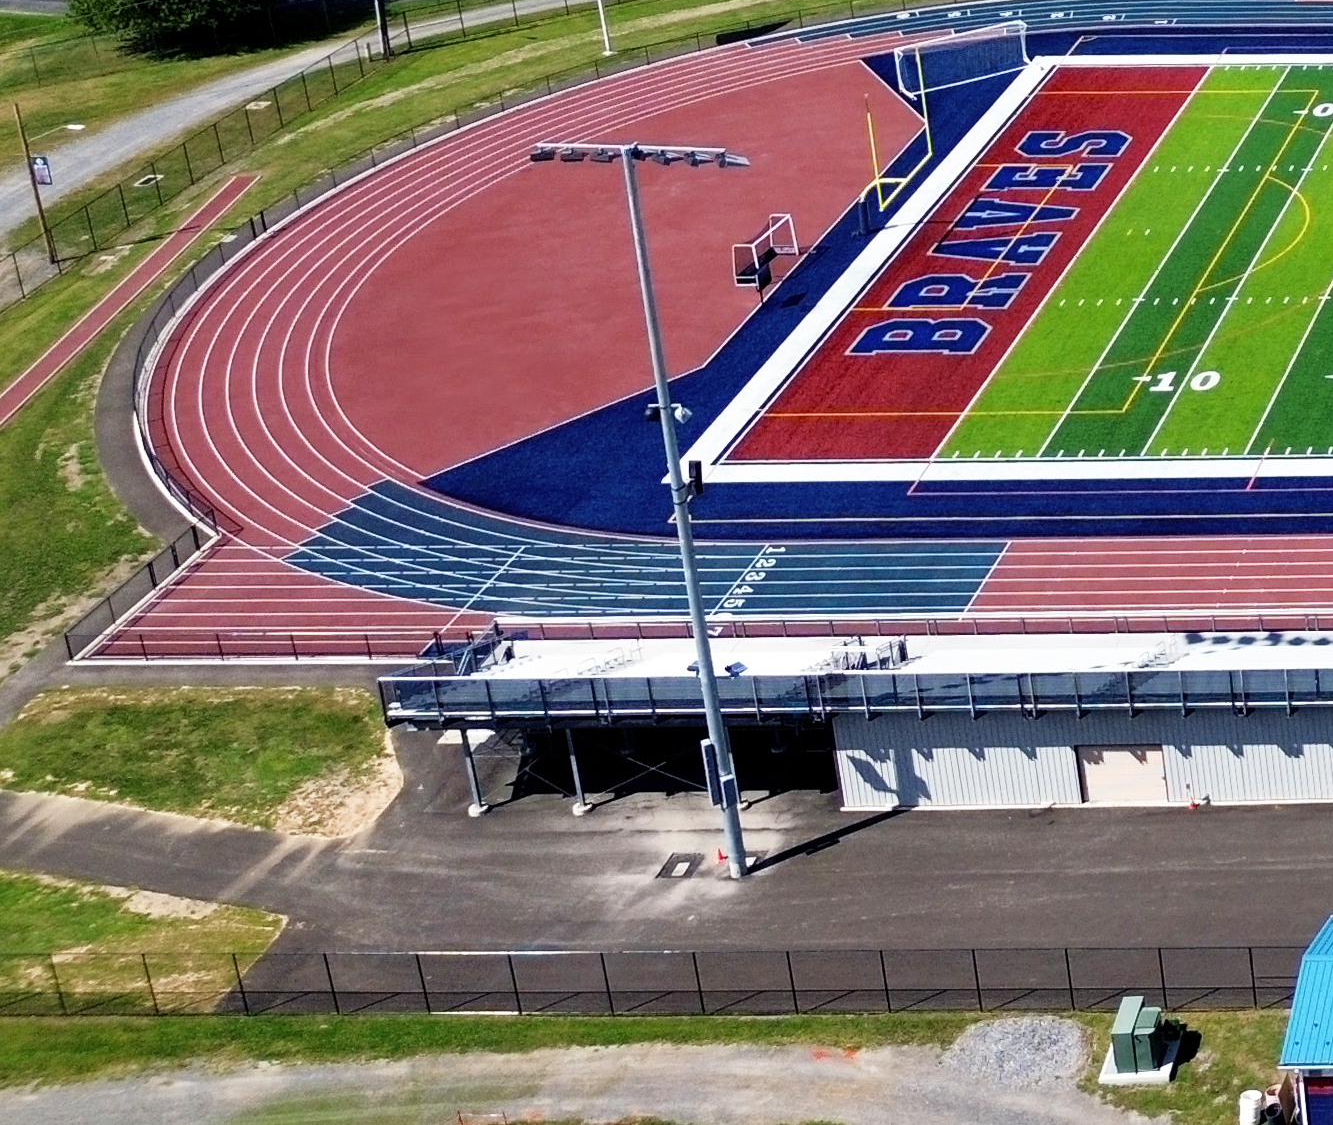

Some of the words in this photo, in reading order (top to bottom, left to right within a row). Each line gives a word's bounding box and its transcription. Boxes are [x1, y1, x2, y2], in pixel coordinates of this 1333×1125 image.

[844, 130, 1133, 355] BRAVES
[1146, 370, 1221, 393] 10
[765, 546, 786, 554] 1
[755, 558, 776, 568] 2
[744, 571, 766, 581] 3
[732, 585, 754, 594] 4
[723, 598, 745, 608] 5
